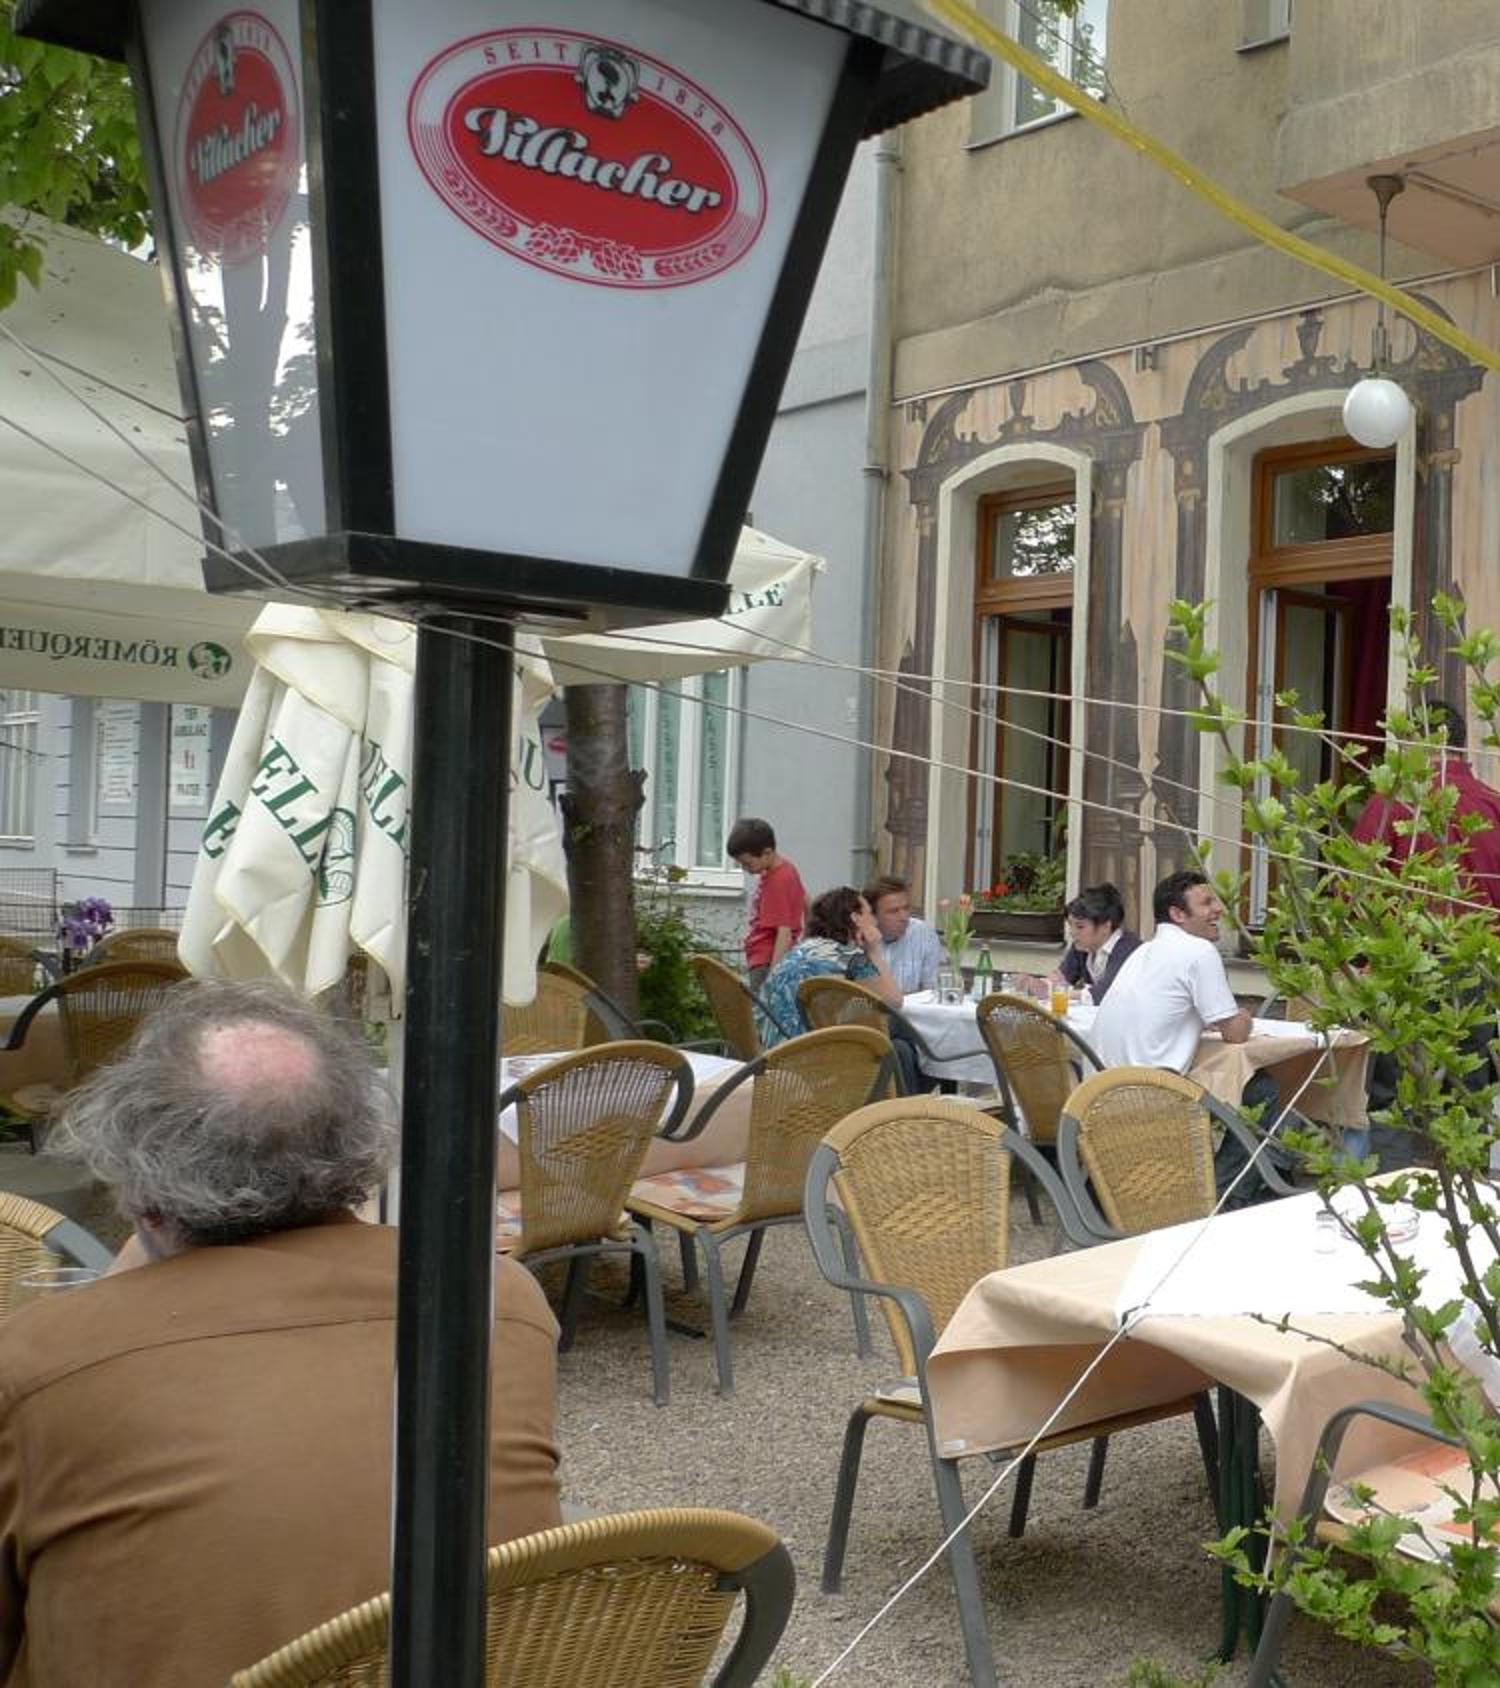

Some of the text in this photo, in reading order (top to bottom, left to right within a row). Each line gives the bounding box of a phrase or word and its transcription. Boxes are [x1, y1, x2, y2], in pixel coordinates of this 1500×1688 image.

[482, 40, 725, 137] SEIT 1858
[463, 106, 722, 214] Villacher
